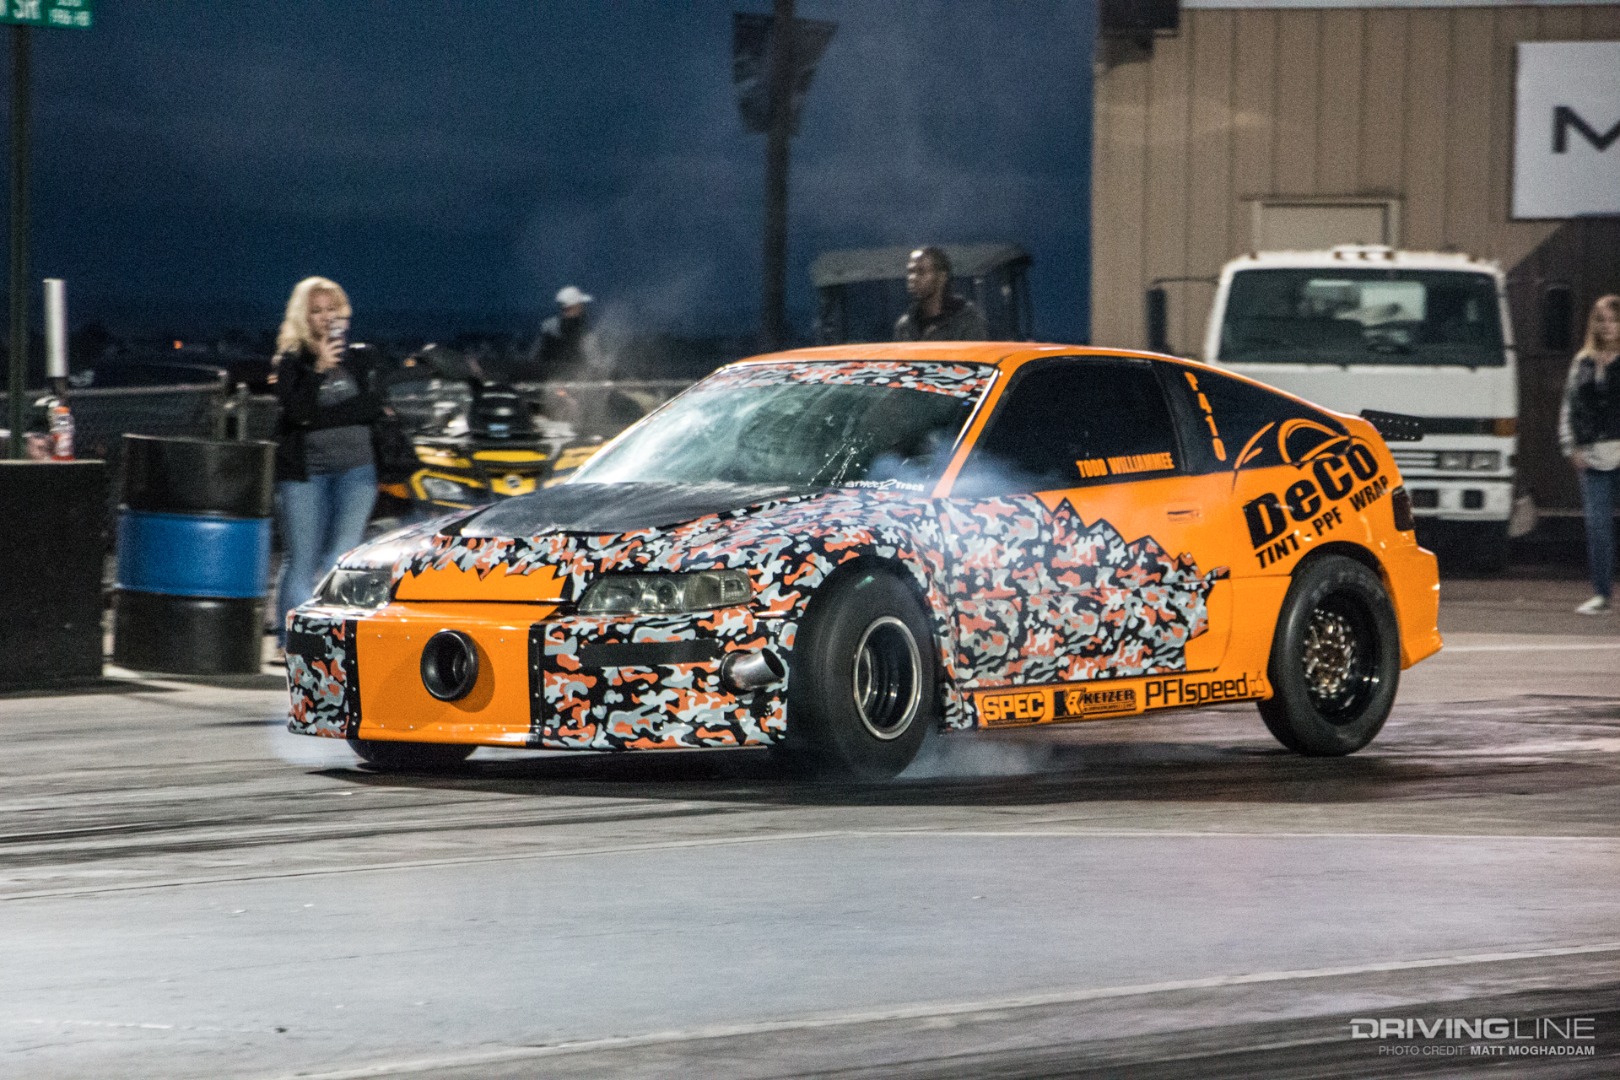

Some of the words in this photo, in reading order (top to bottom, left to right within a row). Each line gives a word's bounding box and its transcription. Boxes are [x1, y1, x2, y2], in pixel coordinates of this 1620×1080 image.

[1076, 458, 1107, 479] TODD
[1255, 533, 1300, 569] TINT
[1312, 507, 1344, 538] PPF
[1349, 475, 1390, 513] WRAP
[982, 691, 1045, 722] SPEC
[1083, 689, 1135, 705] KEIZER
